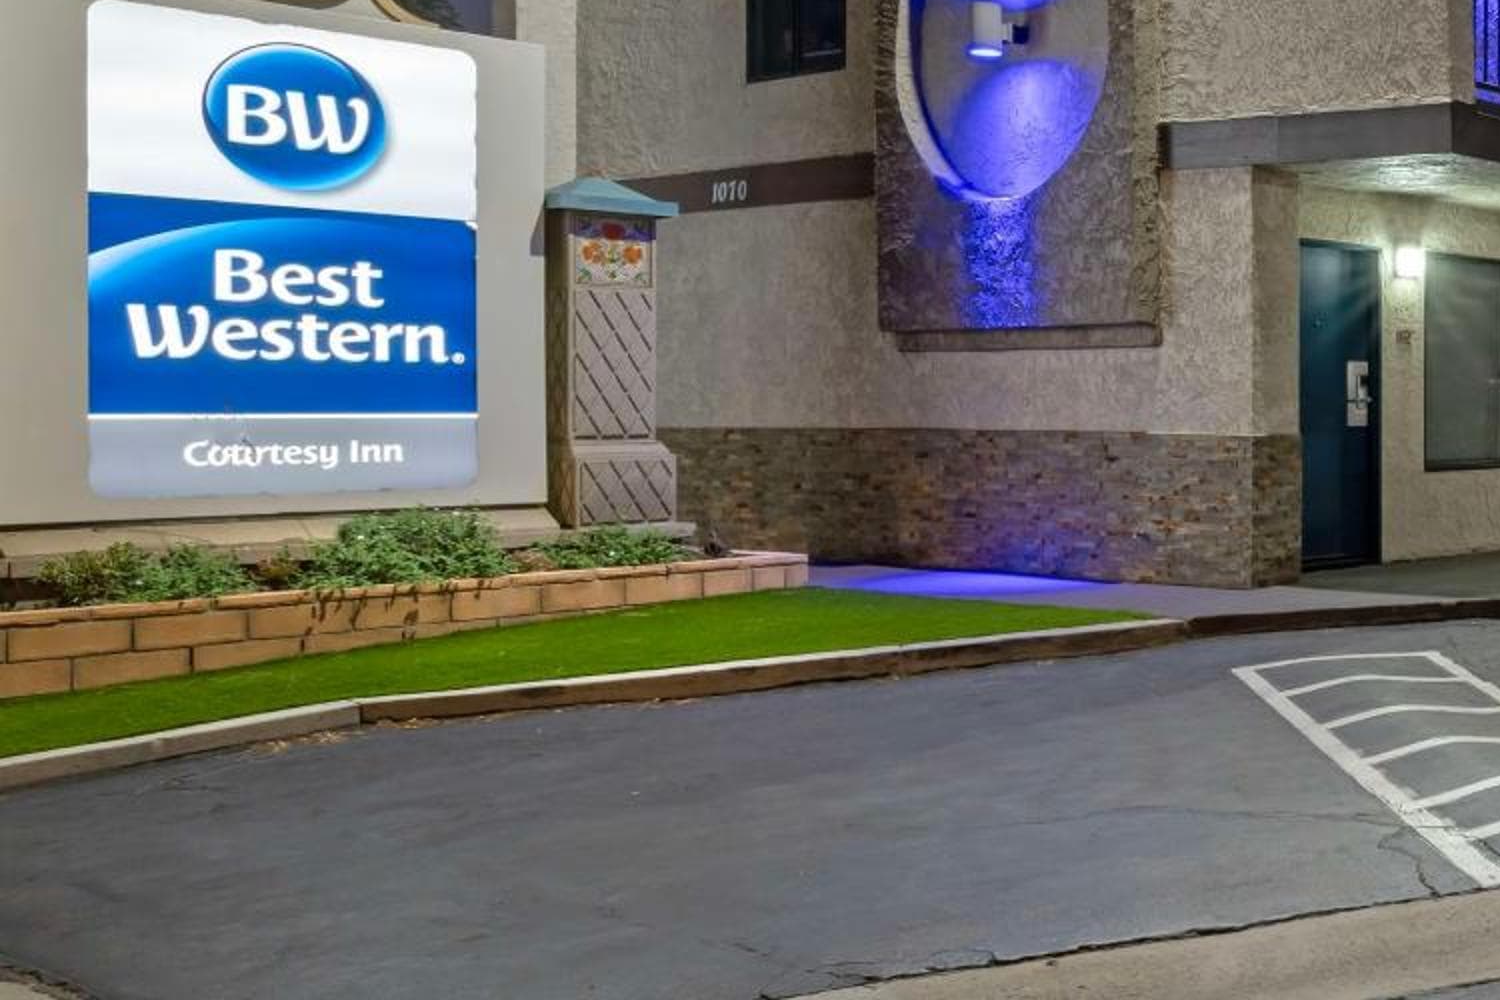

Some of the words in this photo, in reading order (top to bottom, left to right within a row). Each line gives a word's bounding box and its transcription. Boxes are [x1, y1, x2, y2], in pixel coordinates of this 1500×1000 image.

[227, 84, 370, 156] BW
[711, 180, 748, 204] 1070
[213, 248, 385, 308] Best
[350, 439, 404, 464] Inn
